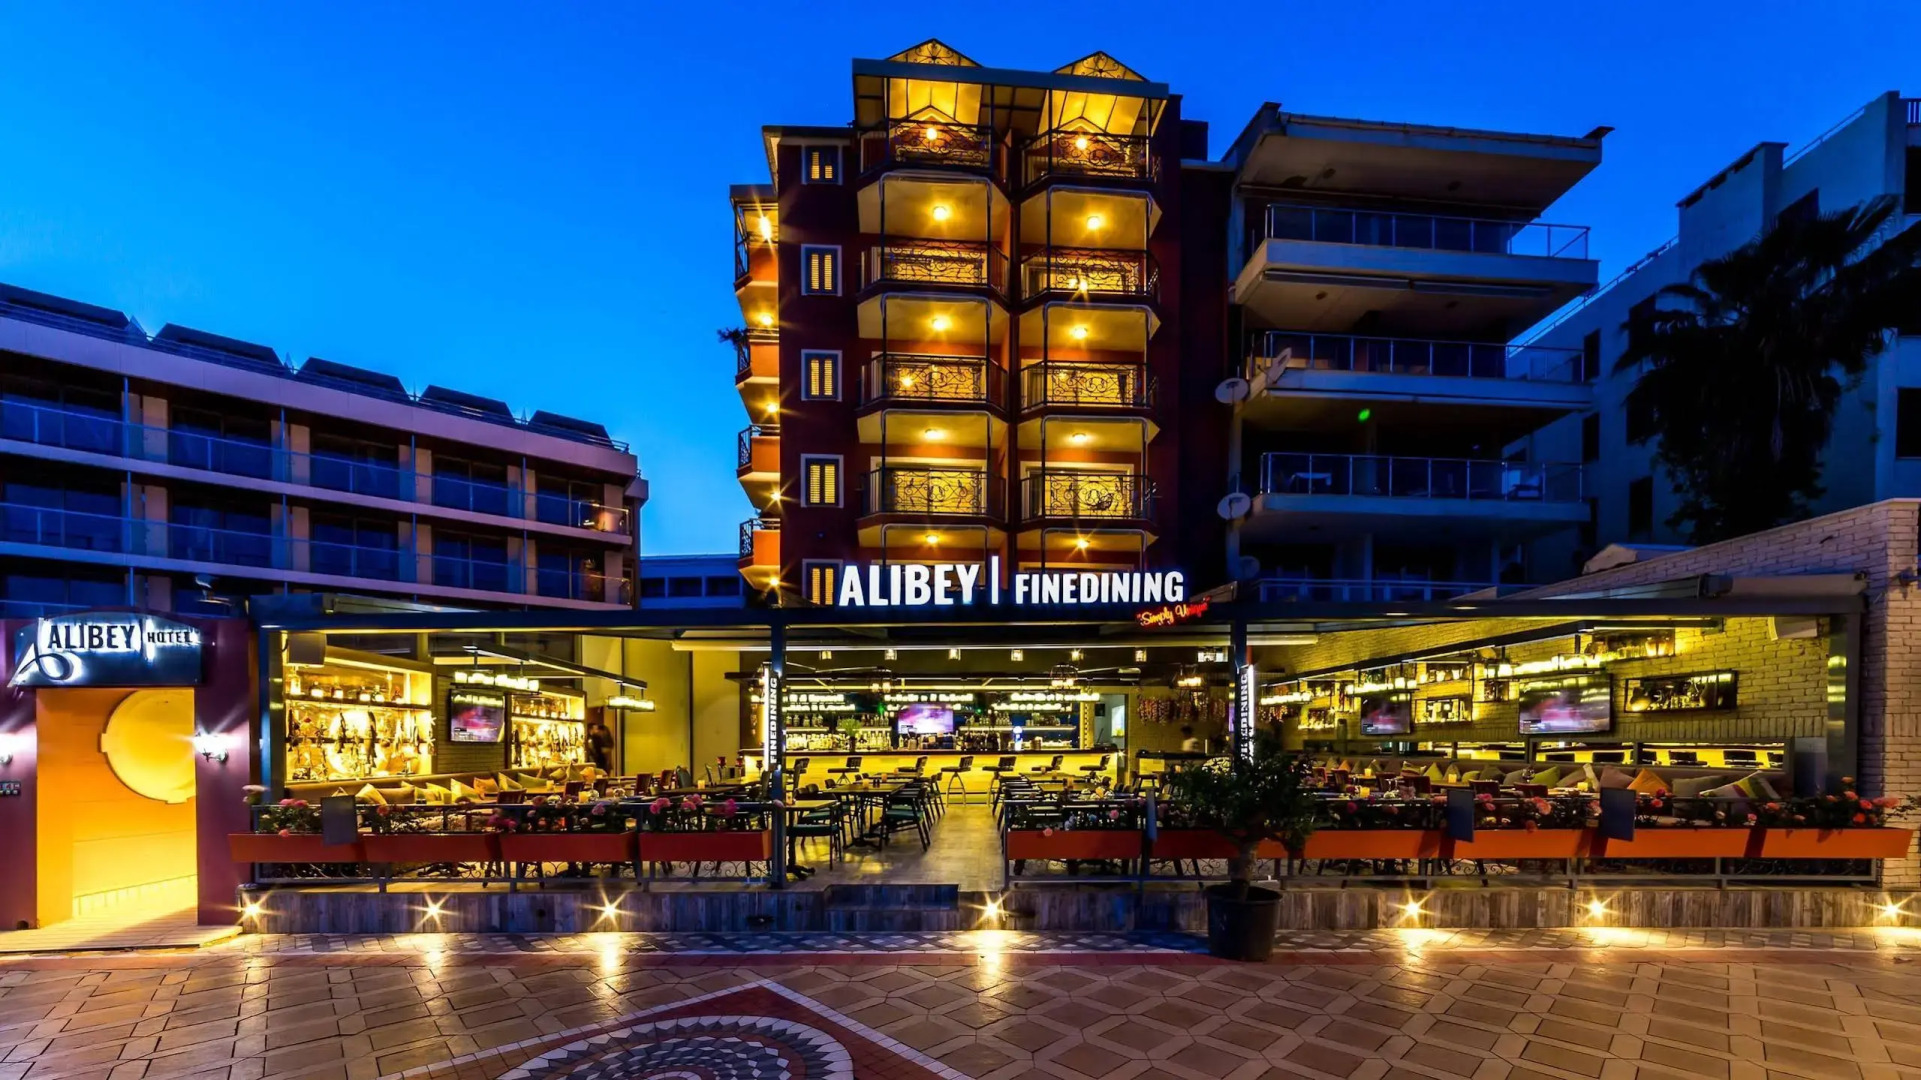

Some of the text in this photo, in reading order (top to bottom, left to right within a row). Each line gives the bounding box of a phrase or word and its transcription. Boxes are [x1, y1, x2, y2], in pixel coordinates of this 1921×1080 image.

[839, 564, 1184, 606] ALIBEY FINEDINING
[48, 625, 136, 649] ALIBEY
[769, 677, 778, 764] FINEDINING
